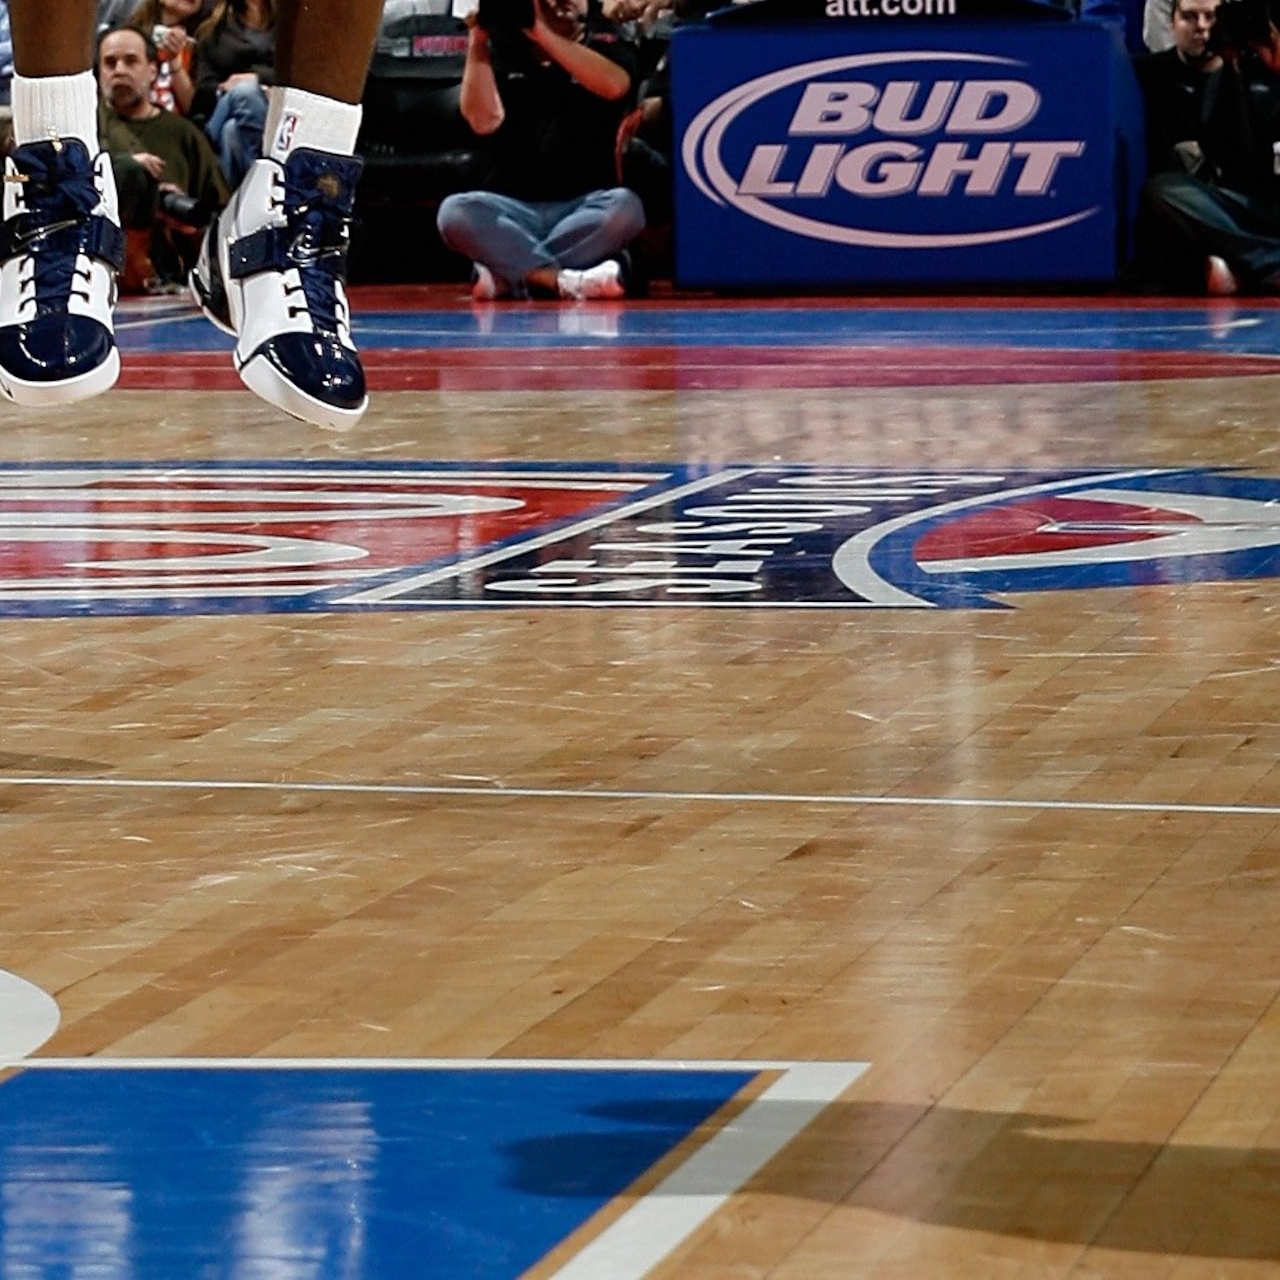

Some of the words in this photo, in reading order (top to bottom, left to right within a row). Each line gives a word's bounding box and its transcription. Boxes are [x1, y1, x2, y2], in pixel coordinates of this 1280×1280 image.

[788, 80, 1041, 136] BUD
[735, 141, 1086, 198] LIGHT
[484, 474, 1006, 594] SEASONS
